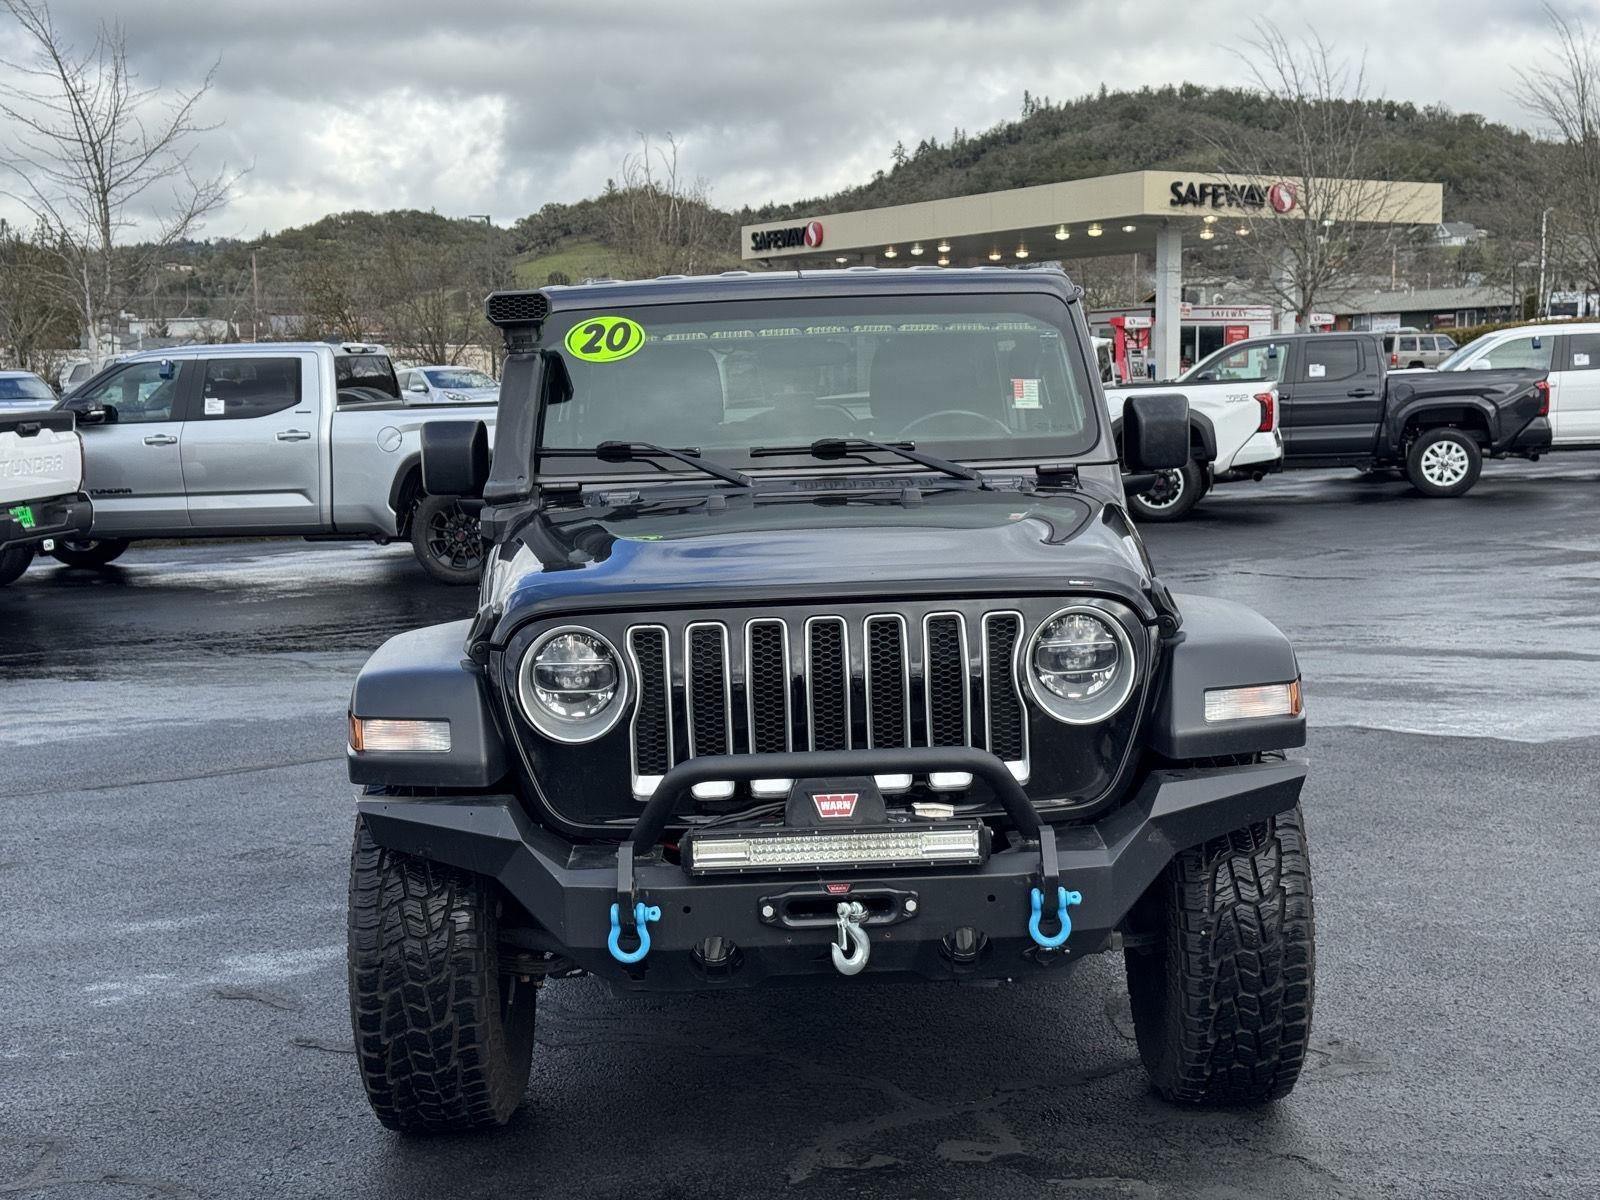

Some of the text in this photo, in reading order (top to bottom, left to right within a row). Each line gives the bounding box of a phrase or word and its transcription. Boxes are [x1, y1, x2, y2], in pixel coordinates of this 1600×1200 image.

[1211, 310, 1248, 318] SAFEWAY
[580, 321, 631, 354] 20
[0, 454, 64, 477] TUNDRA
[820, 800, 852, 811] WARN
